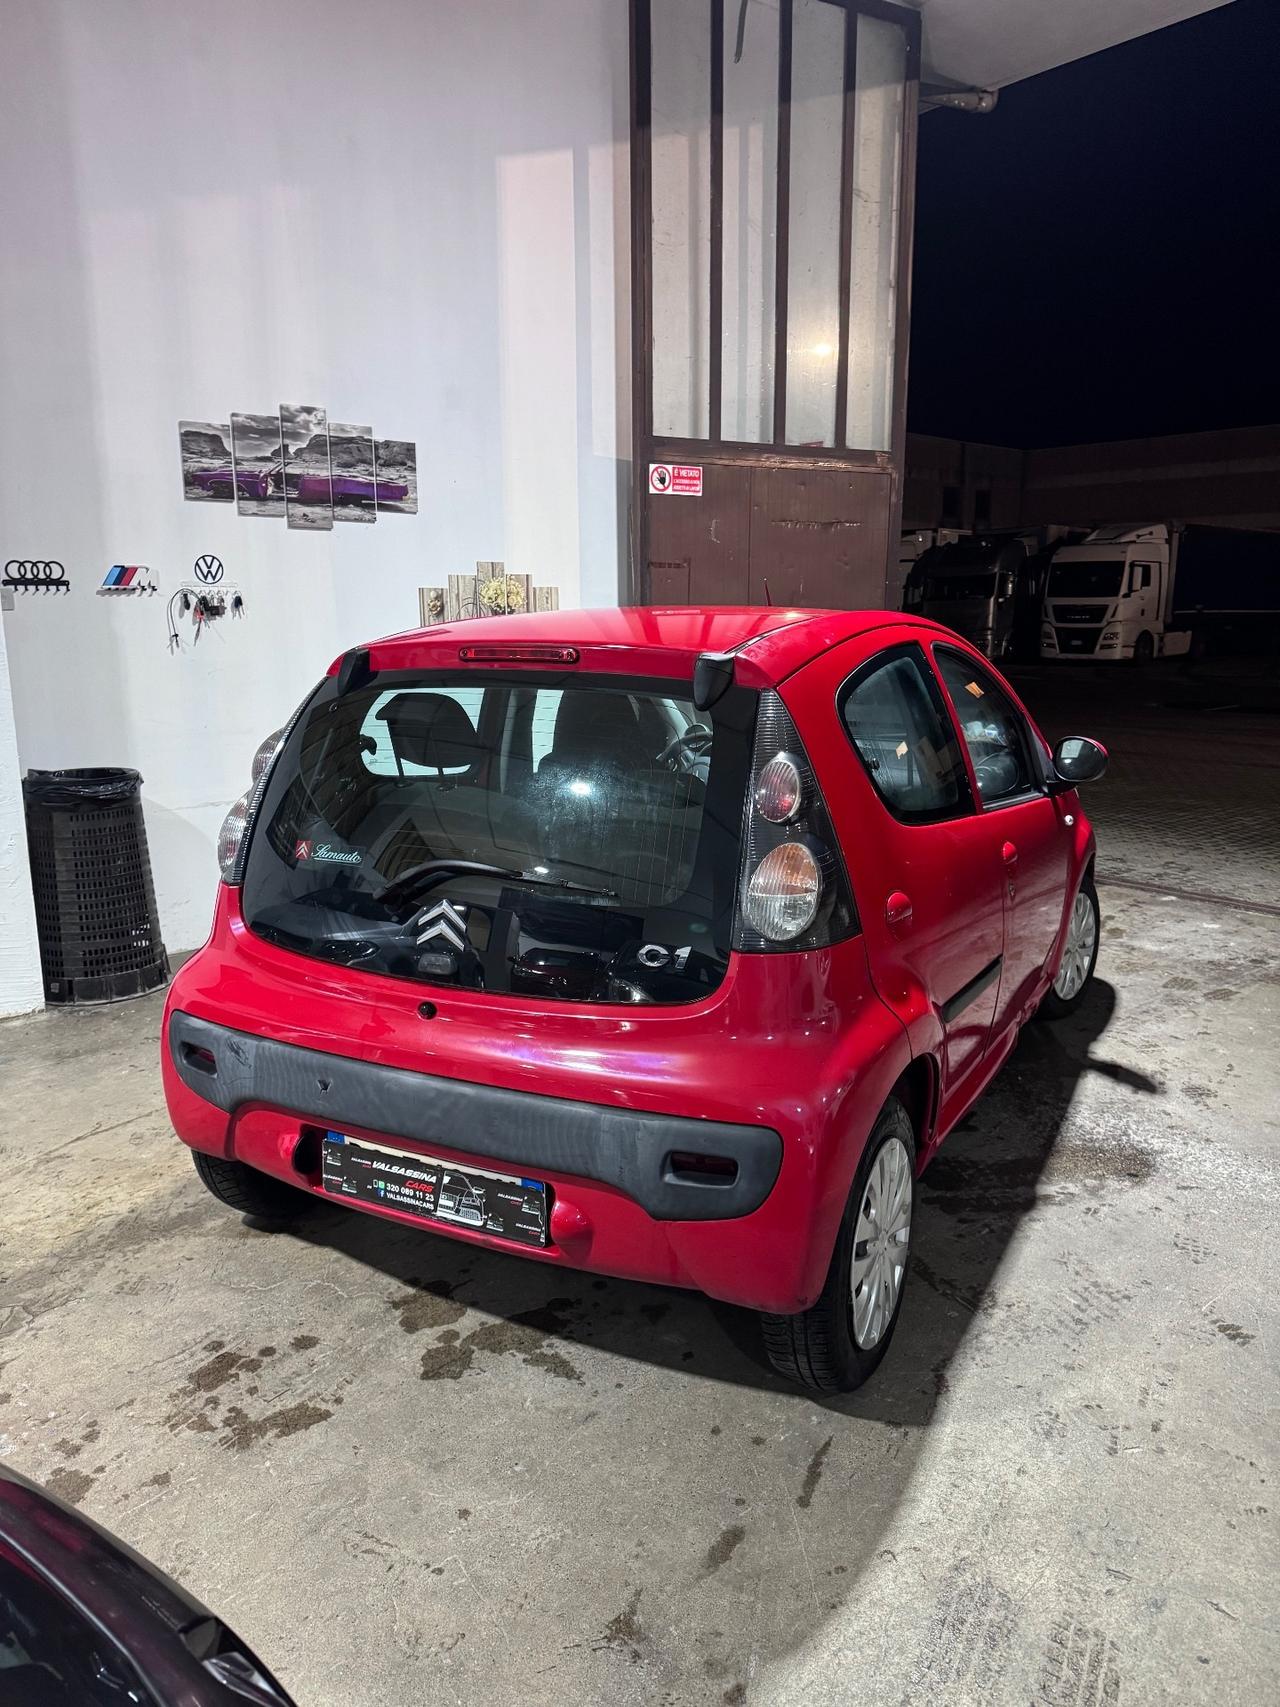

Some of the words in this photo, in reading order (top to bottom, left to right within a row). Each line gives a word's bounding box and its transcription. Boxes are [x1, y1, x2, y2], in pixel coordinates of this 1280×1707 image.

[638, 944, 692, 969] C1
[372, 1161, 437, 1183] VALSASSINA
[386, 1183, 400, 1192] 320
[415, 1191, 423, 1199] 11
[425, 1193, 435, 1202] 23
[405, 1180, 434, 1193] CARS
[386, 1192, 435, 1210] VALSASSINACARS
